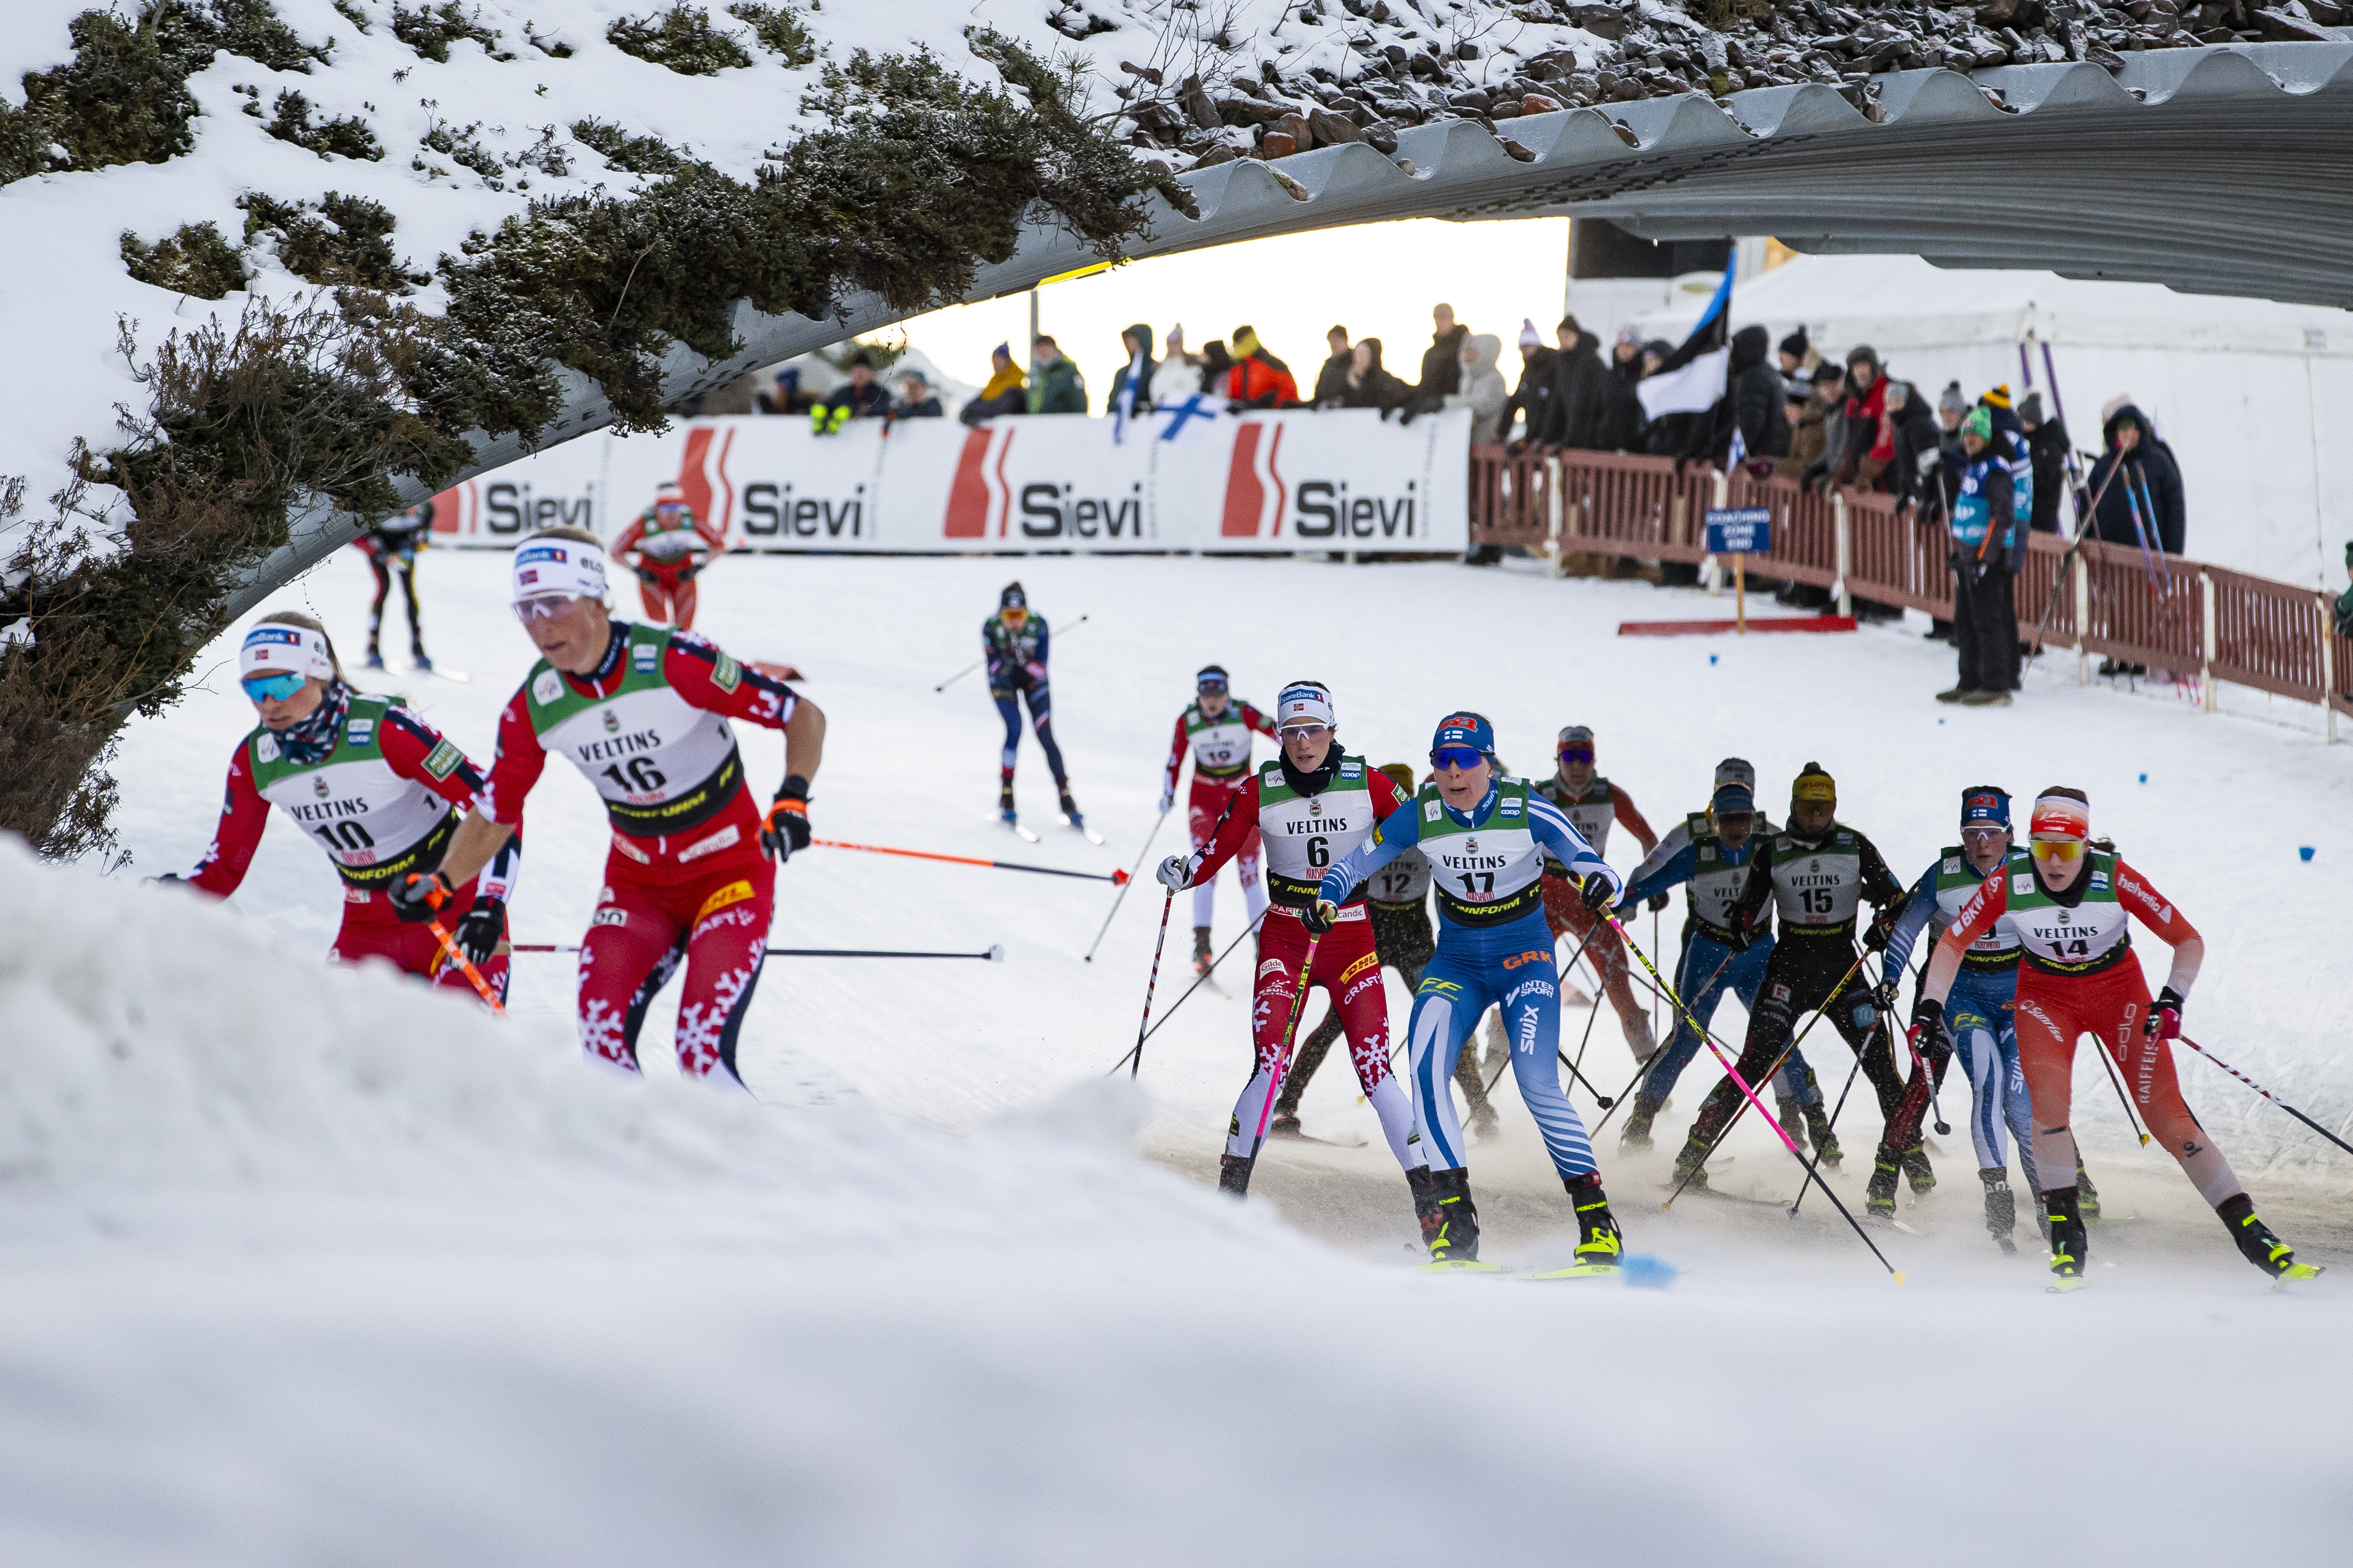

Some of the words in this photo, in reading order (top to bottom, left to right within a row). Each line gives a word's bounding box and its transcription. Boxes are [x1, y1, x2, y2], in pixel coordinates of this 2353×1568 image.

[486, 481, 593, 535] Sievi
[743, 482, 865, 537] Sievi
[1020, 483, 1142, 538] Sievi
[1295, 481, 1416, 538] Sievi
[579, 729, 661, 762] VELTINS
[601, 756, 667, 793] 16
[291, 797, 368, 820] VELTINS
[313, 821, 374, 851] 10
[1286, 818, 1347, 835] VELTINS
[1306, 836, 1330, 868] 6
[1442, 855, 1506, 869] VELTINS
[1381, 874, 1410, 893] 12
[1456, 872, 1495, 893] 17
[1791, 874, 1840, 887] VELTINS
[1714, 888, 1740, 897] VELT
[1799, 888, 1833, 914] 15
[2117, 873, 2162, 913] helvetia
[1337, 909, 1364, 918] candic
[1721, 899, 1736, 918] 2
[1962, 890, 1985, 927] BKW
[2033, 926, 2099, 938] VELTINS
[1503, 950, 1554, 970] GRK
[2045, 940, 2091, 958] 14
[1262, 960, 1282, 970] Gilde
[1344, 975, 1379, 1005] CRAFT
[1520, 987, 1554, 998] SPORT
[1522, 980, 1554, 992] INTER
[2028, 1006, 2064, 1042] Sunrise
[2117, 1003, 2138, 1061] odlo
[1577, 1201, 1607, 1212] FISCHER
